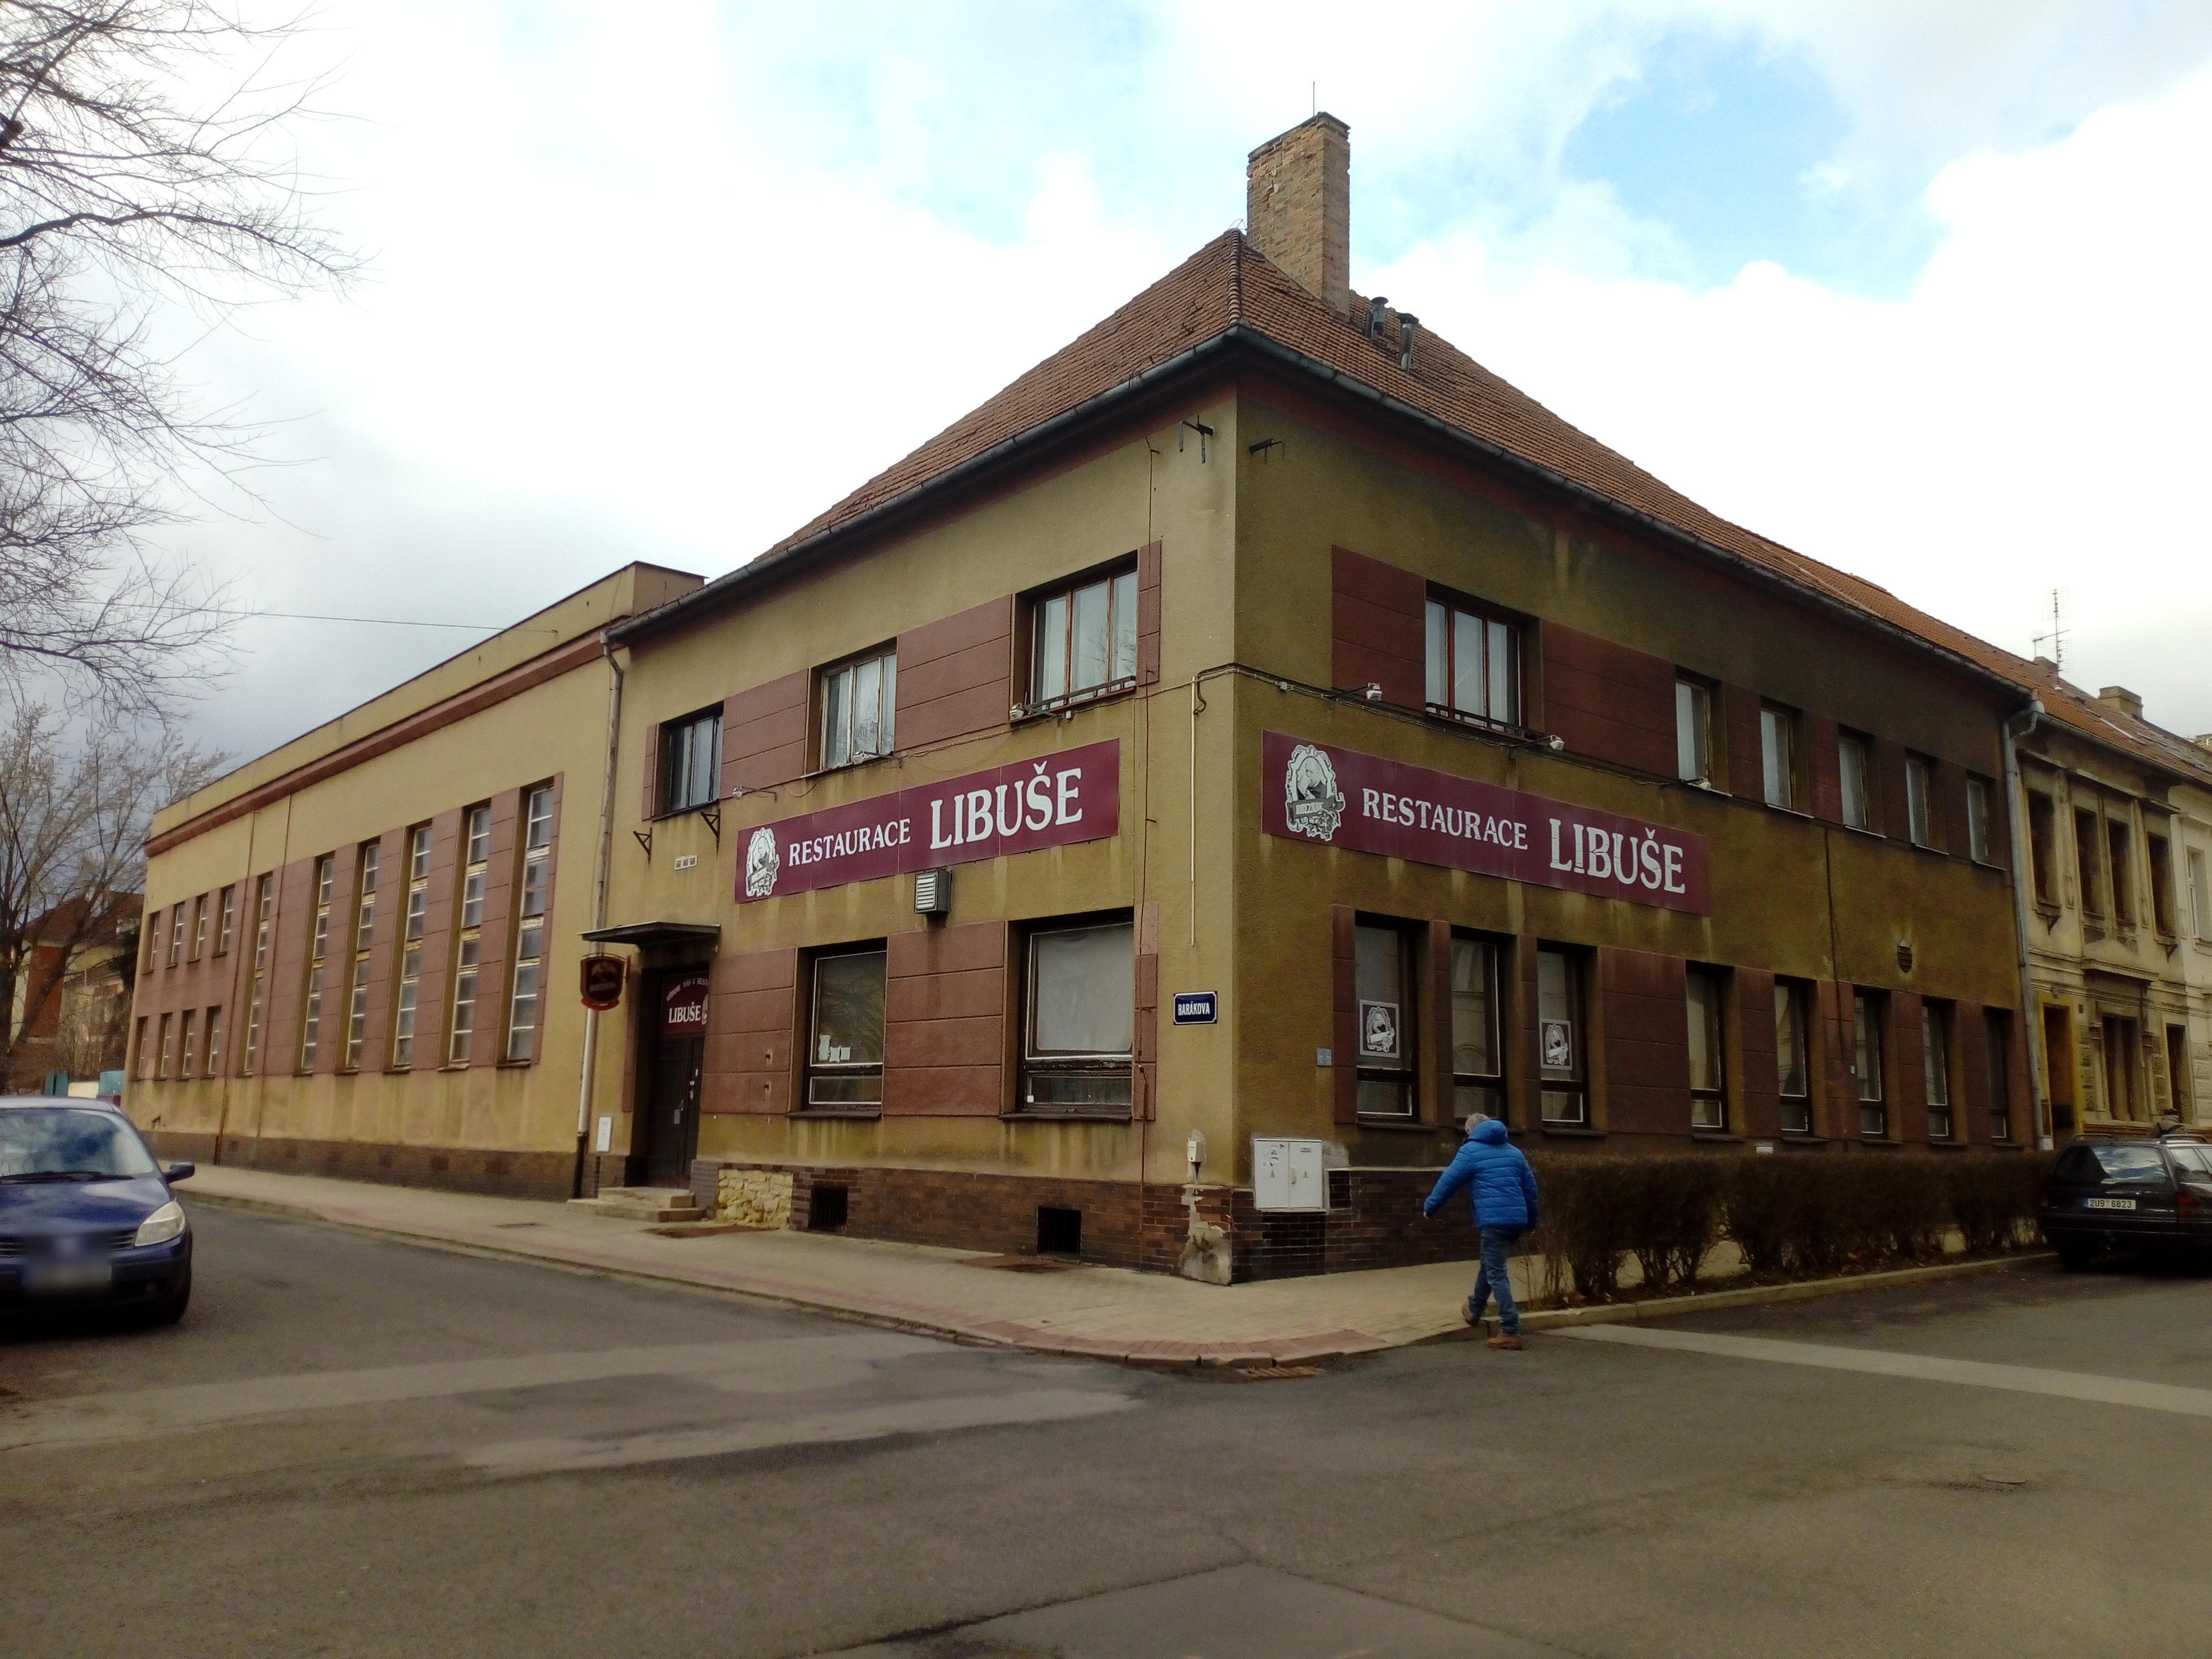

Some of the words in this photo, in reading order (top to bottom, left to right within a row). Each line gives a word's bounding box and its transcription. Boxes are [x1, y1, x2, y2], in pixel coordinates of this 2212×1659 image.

[788, 818, 911, 867] RESTAURACE
[930, 760, 1082, 849] LIBUŠE
[1362, 787, 1528, 850] RESTAURACE
[1549, 818, 1686, 894] LIBUŠE
[668, 1001, 701, 1023] LIBUŠE
[1178, 1001, 1210, 1015] BARÁKOVA
